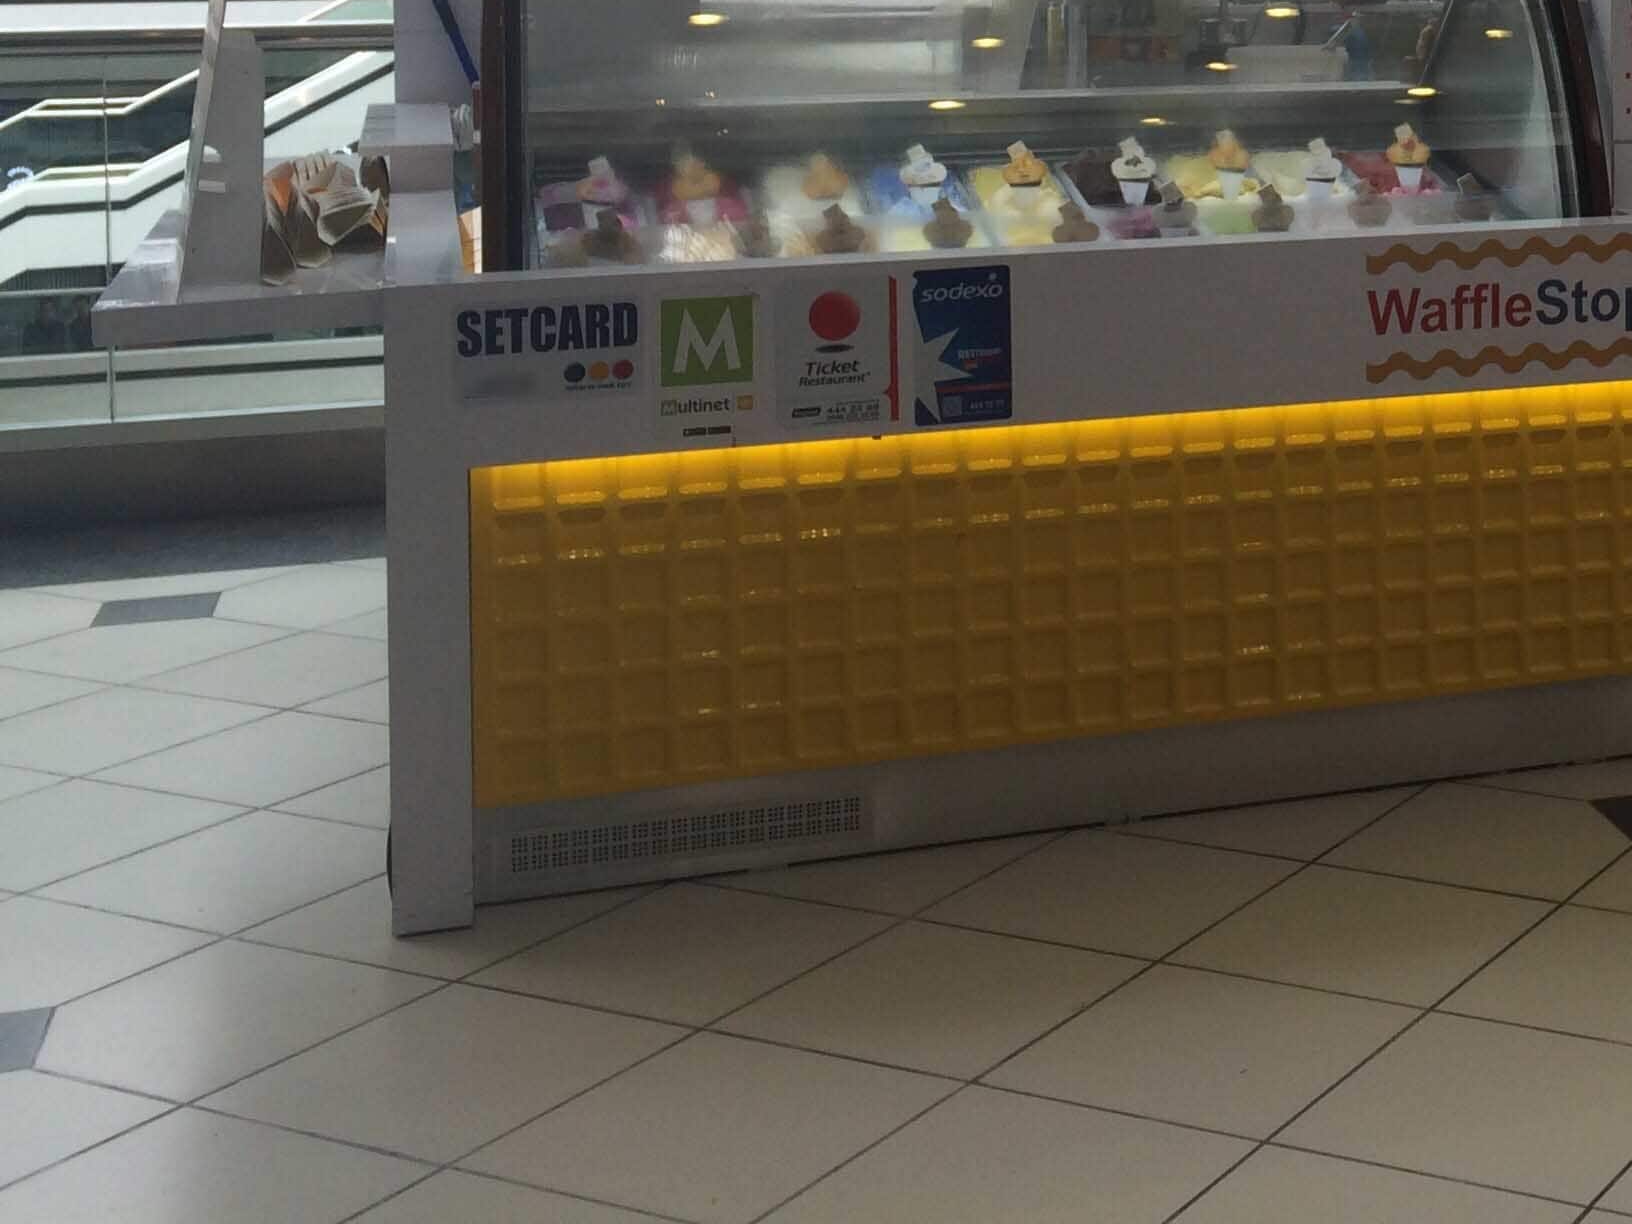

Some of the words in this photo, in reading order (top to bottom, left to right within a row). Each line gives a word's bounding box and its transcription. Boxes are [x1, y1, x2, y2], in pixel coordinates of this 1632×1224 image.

[921, 282, 1003, 302] sodexo
[456, 302, 638, 357] SETCARD
[805, 359, 860, 376] Ticket
